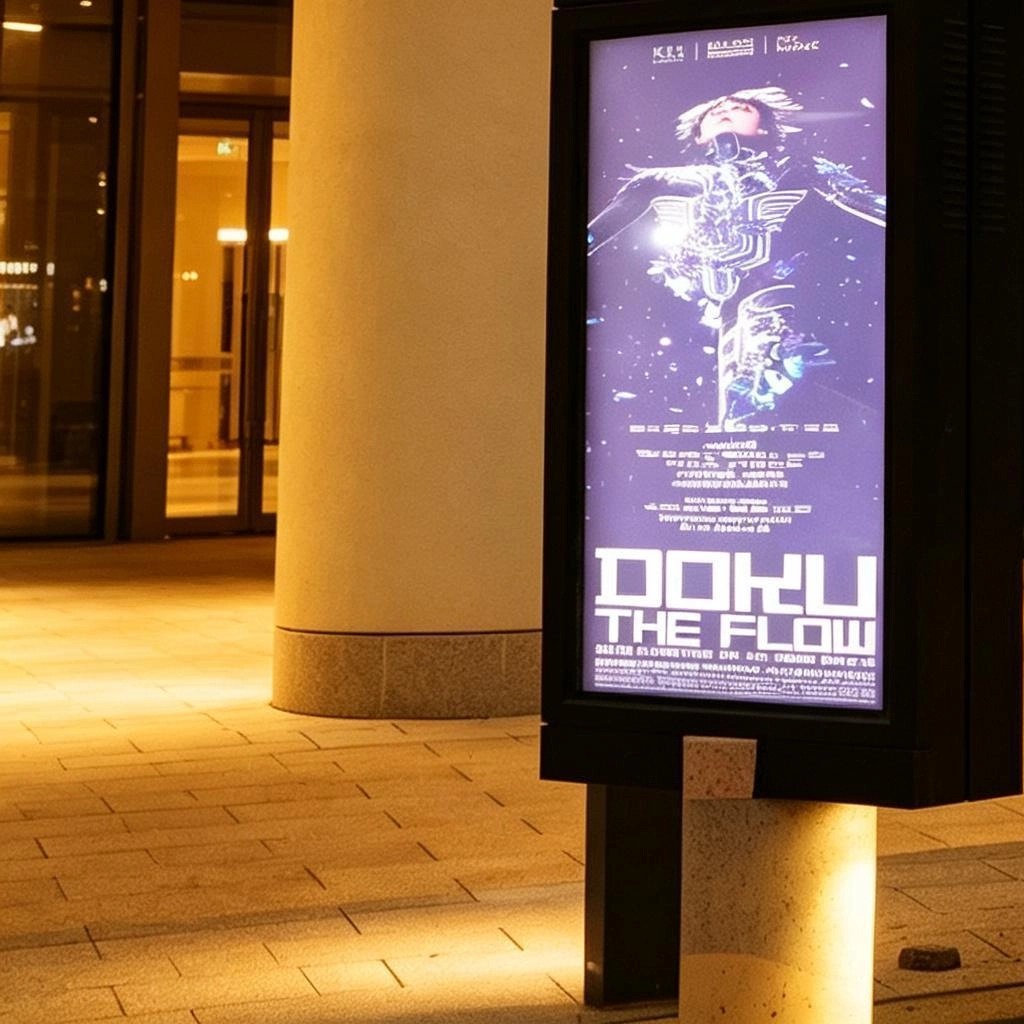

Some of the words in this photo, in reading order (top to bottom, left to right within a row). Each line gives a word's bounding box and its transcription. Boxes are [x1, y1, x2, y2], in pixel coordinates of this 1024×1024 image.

[594, 547, 878, 619] DOKU
[594, 608, 702, 648] THE
[719, 613, 877, 656] FLOW
